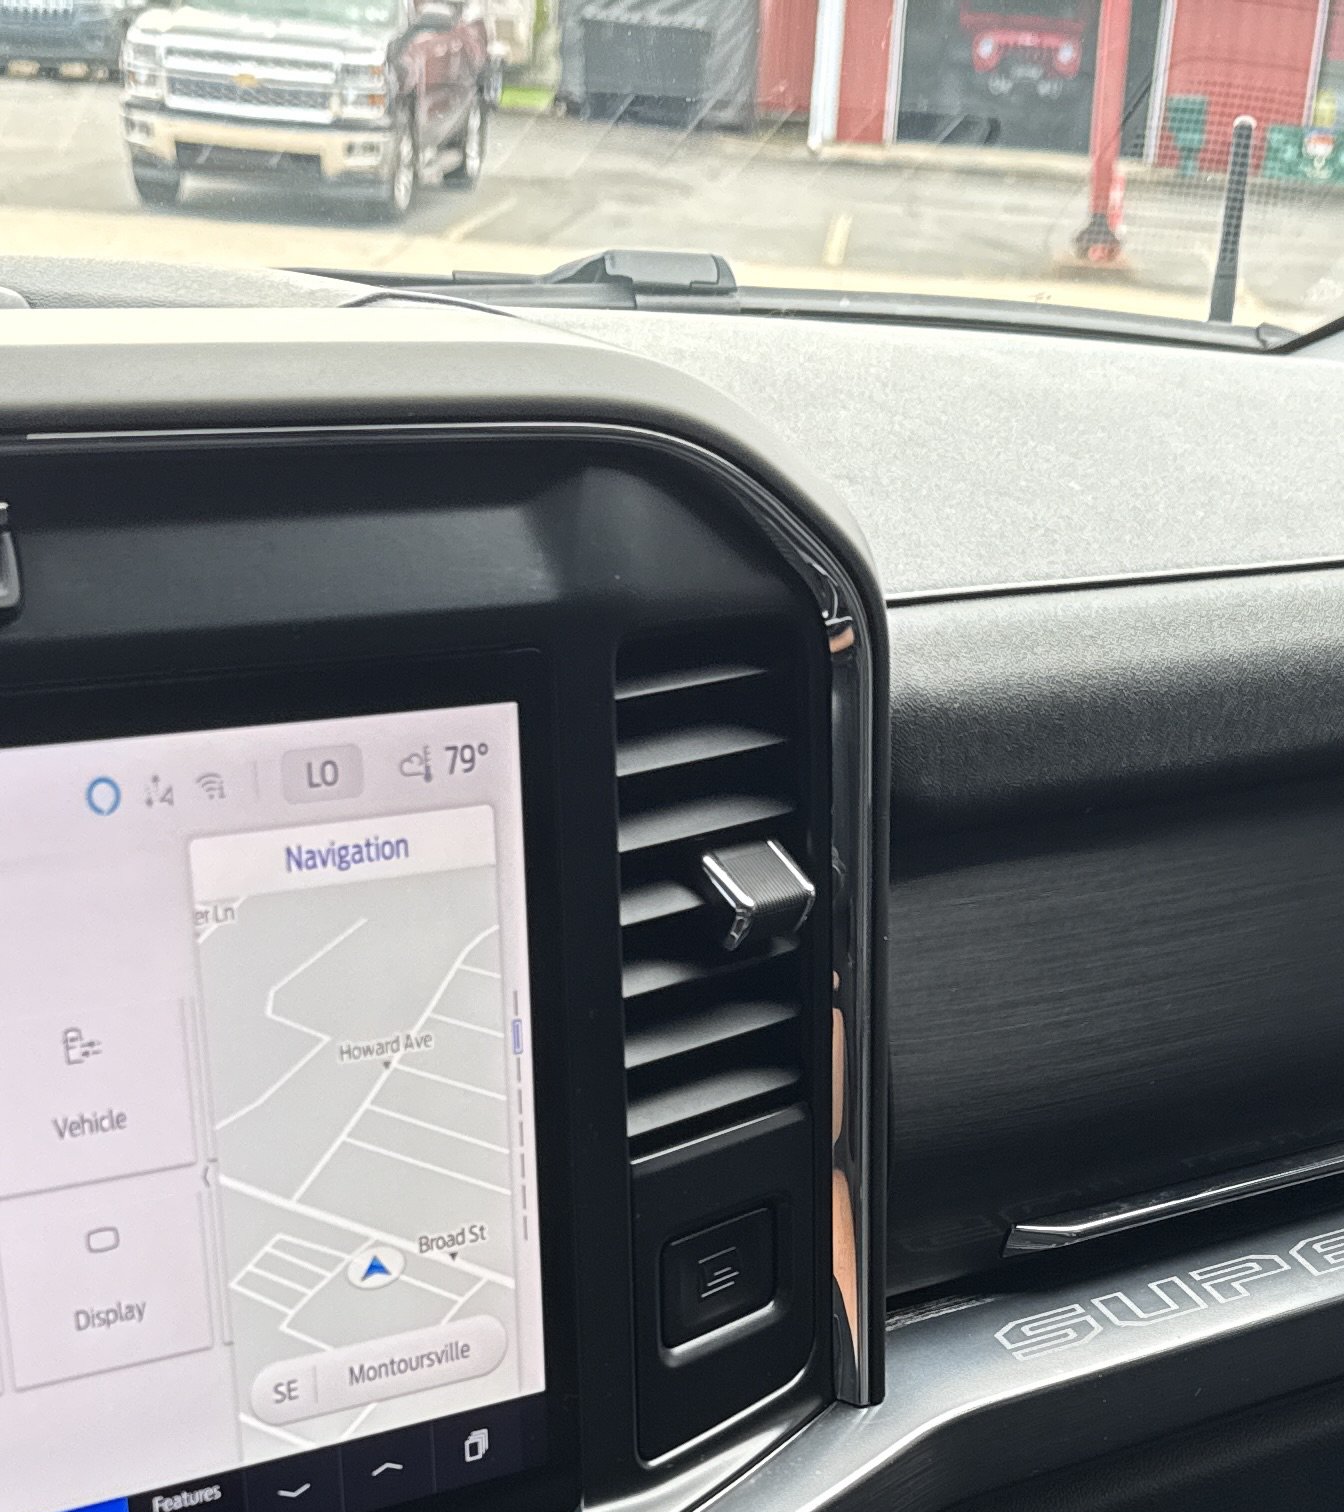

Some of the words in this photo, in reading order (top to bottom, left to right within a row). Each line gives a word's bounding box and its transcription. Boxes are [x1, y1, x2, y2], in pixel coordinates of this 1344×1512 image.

[306, 759, 339, 788] LO
[444, 742, 489, 776] 79°
[285, 835, 410, 873] Navigation
[213, 904, 235, 923] Ln
[339, 1035, 401, 1062] Howard
[404, 1033, 433, 1050] Ave
[51, 1108, 127, 1140] Vehicle
[418, 1228, 466, 1254] Broad
[469, 1224, 487, 1243] St
[73, 1301, 148, 1332] Display
[348, 1341, 471, 1386] Montoursville
[273, 1379, 299, 1404] SE
